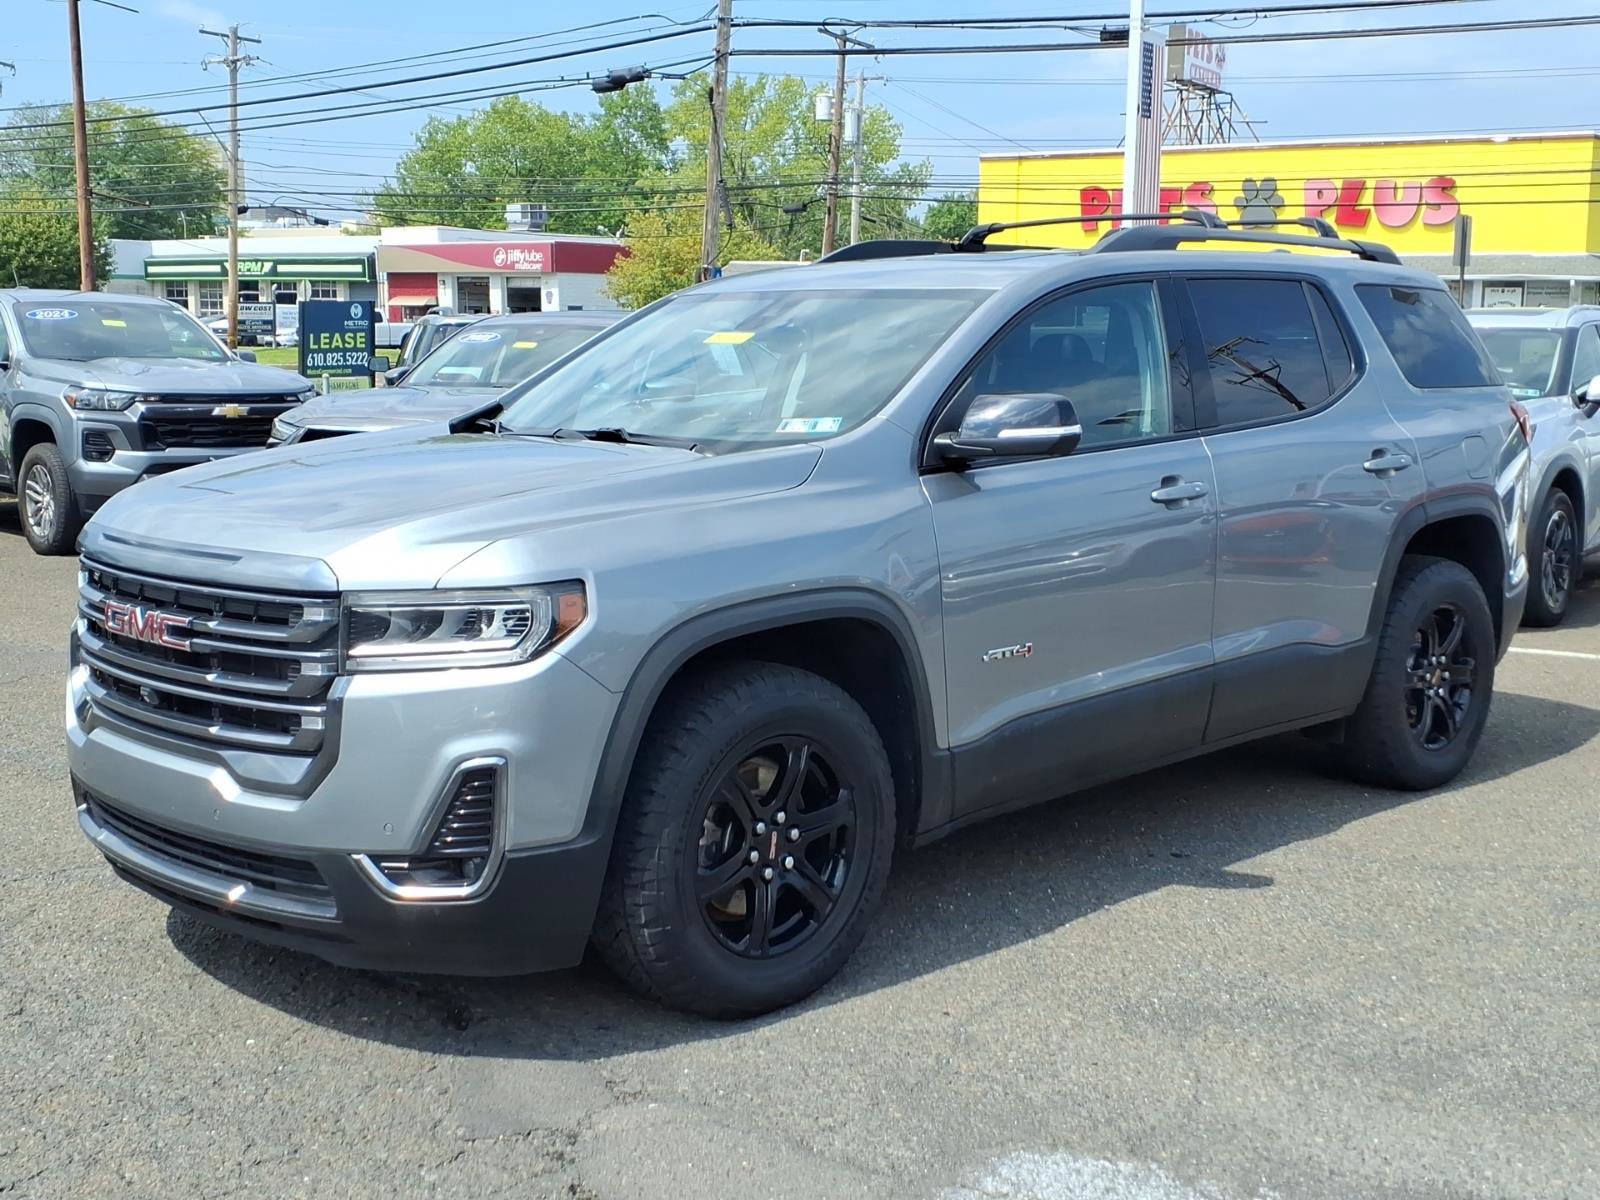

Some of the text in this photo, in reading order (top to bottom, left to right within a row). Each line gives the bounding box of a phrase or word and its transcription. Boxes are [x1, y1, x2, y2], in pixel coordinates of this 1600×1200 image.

[1080, 176, 1460, 231] PTS PLUS
[237, 261, 263, 272] RPM
[35, 309, 69, 319] 2024
[309, 332, 366, 350] LEASE
[307, 352, 369, 367] 610.825.5222
[105, 600, 191, 652] GMC
[982, 642, 1032, 661] AT4
